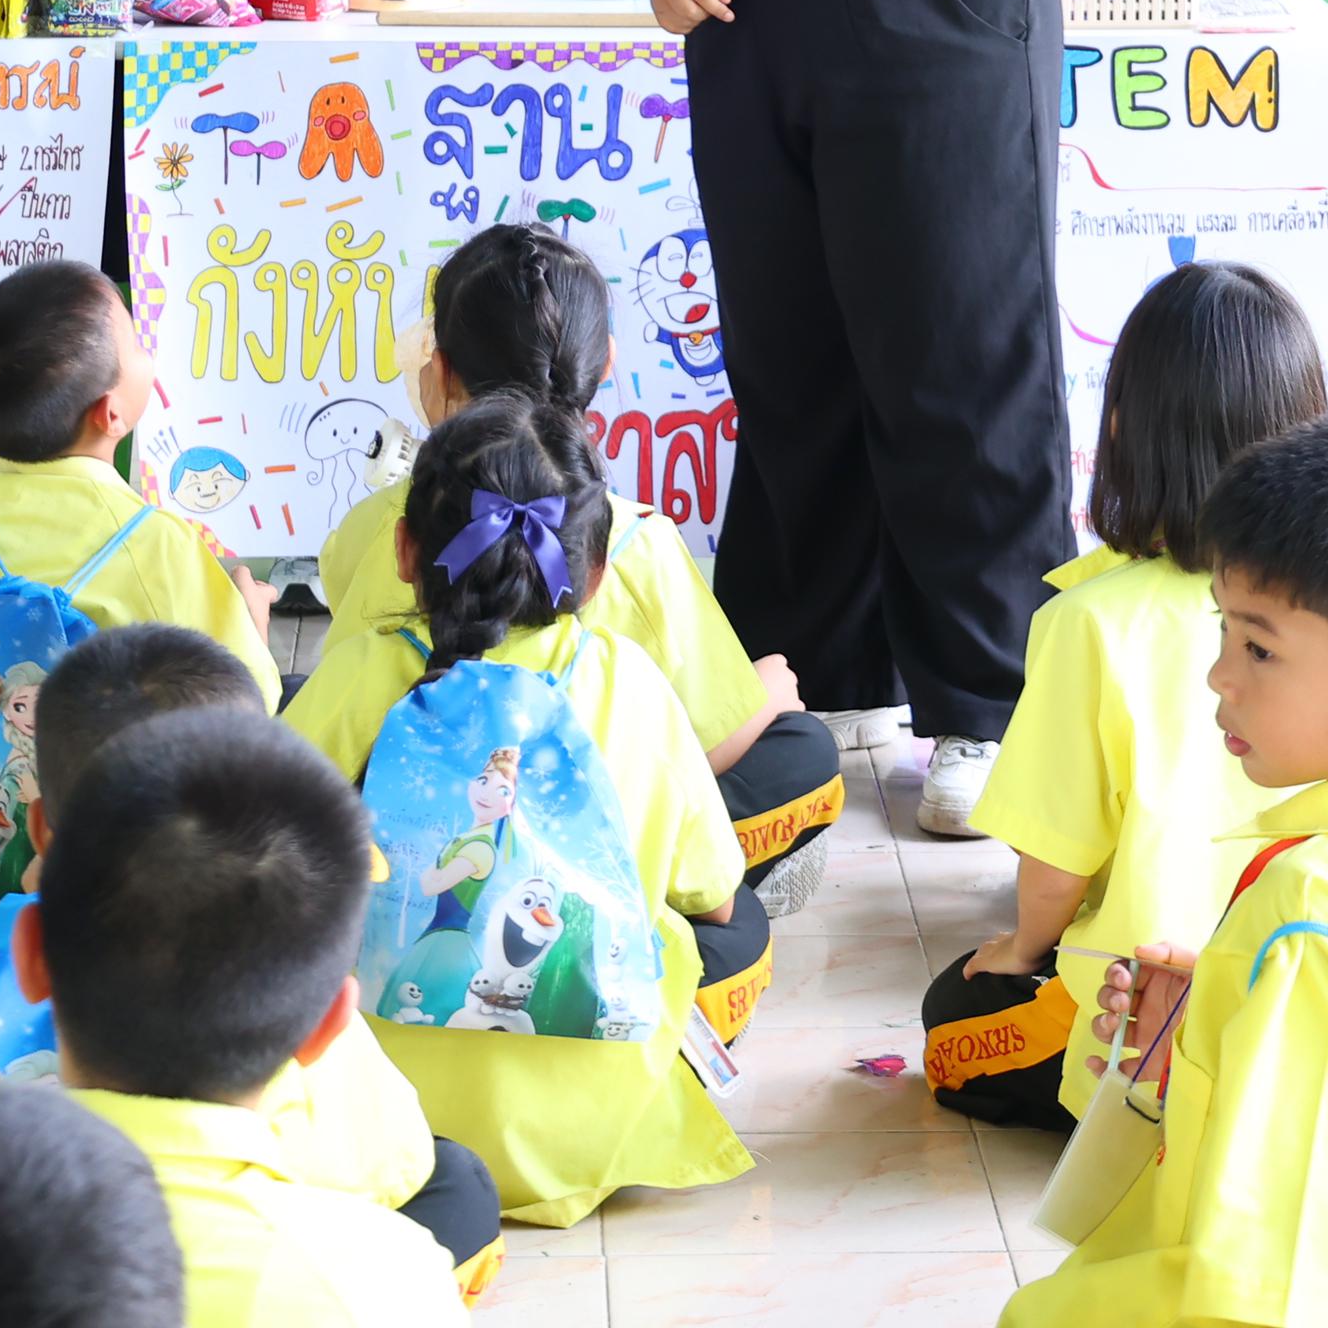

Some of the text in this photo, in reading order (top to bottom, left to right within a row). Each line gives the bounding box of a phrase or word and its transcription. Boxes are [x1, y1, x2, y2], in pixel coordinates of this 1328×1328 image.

[1060, 44, 1280, 133] TEM
[422, 82, 633, 224] ฐาน
[1195, 211, 1238, 235] แรงลม
